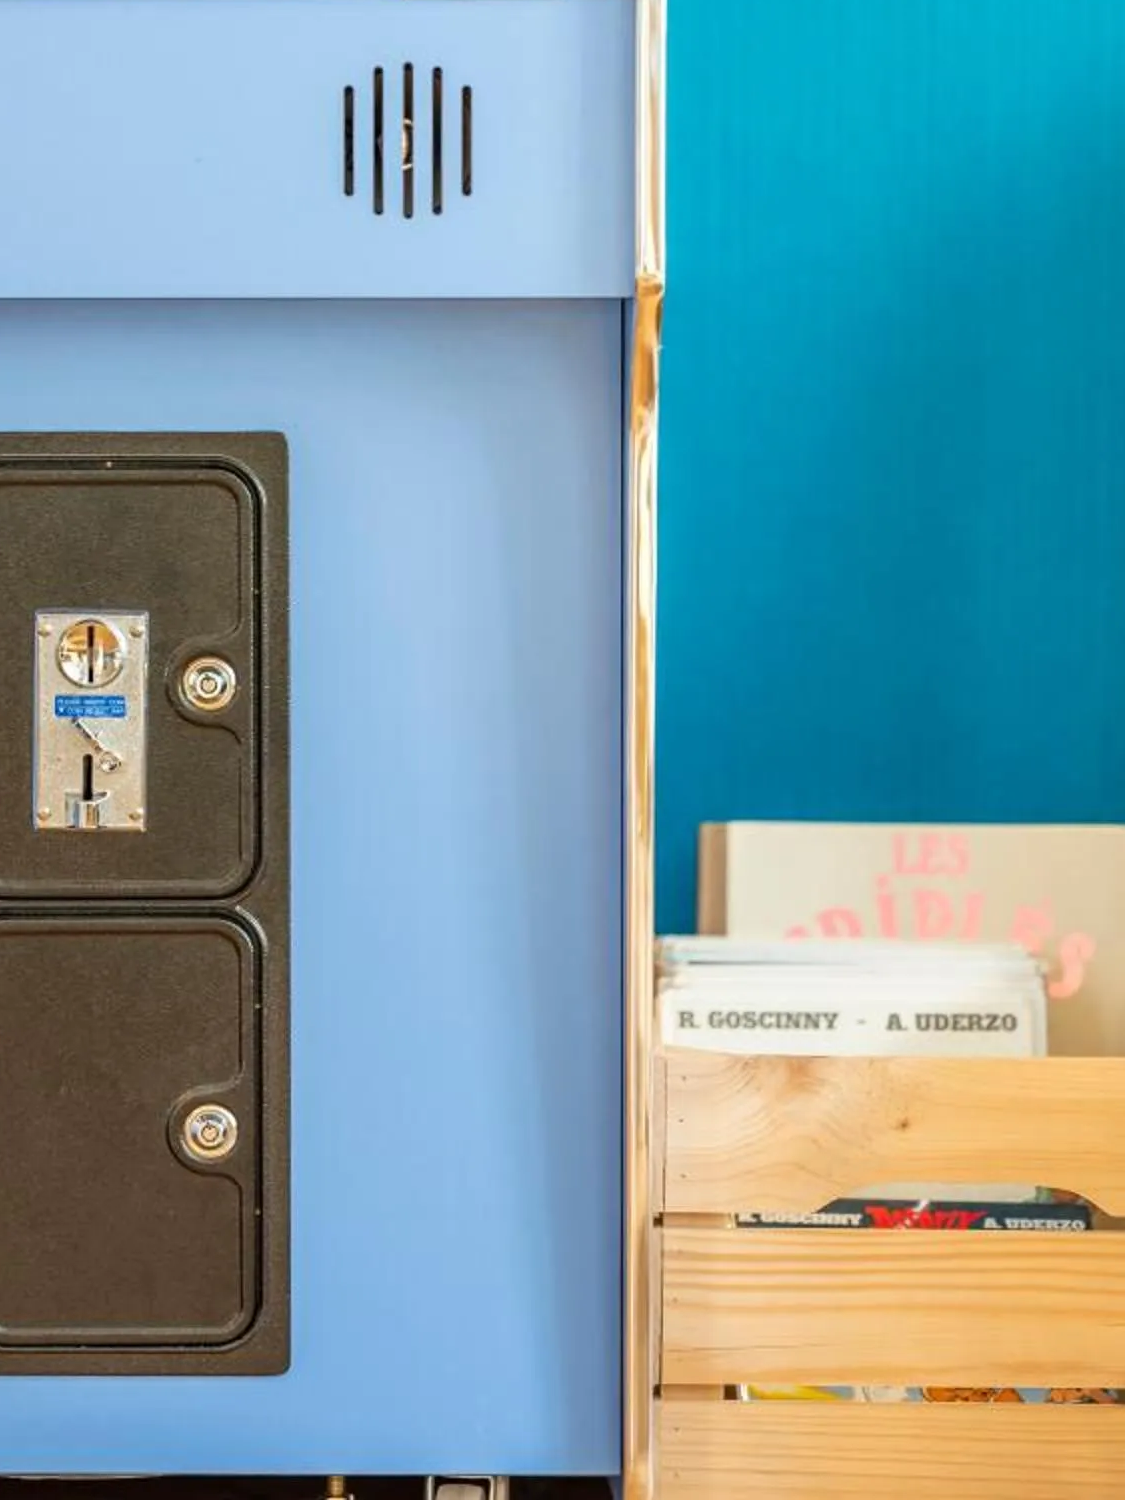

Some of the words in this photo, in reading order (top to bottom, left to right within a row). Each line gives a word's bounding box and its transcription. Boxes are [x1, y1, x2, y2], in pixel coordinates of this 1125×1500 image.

[891, 833, 971, 875] LES
[678, 1011, 701, 1029] R.
[709, 1011, 839, 1030] GOSCINNY
[885, 1013, 908, 1031] A.
[915, 1014, 1018, 1032] UDERZO
